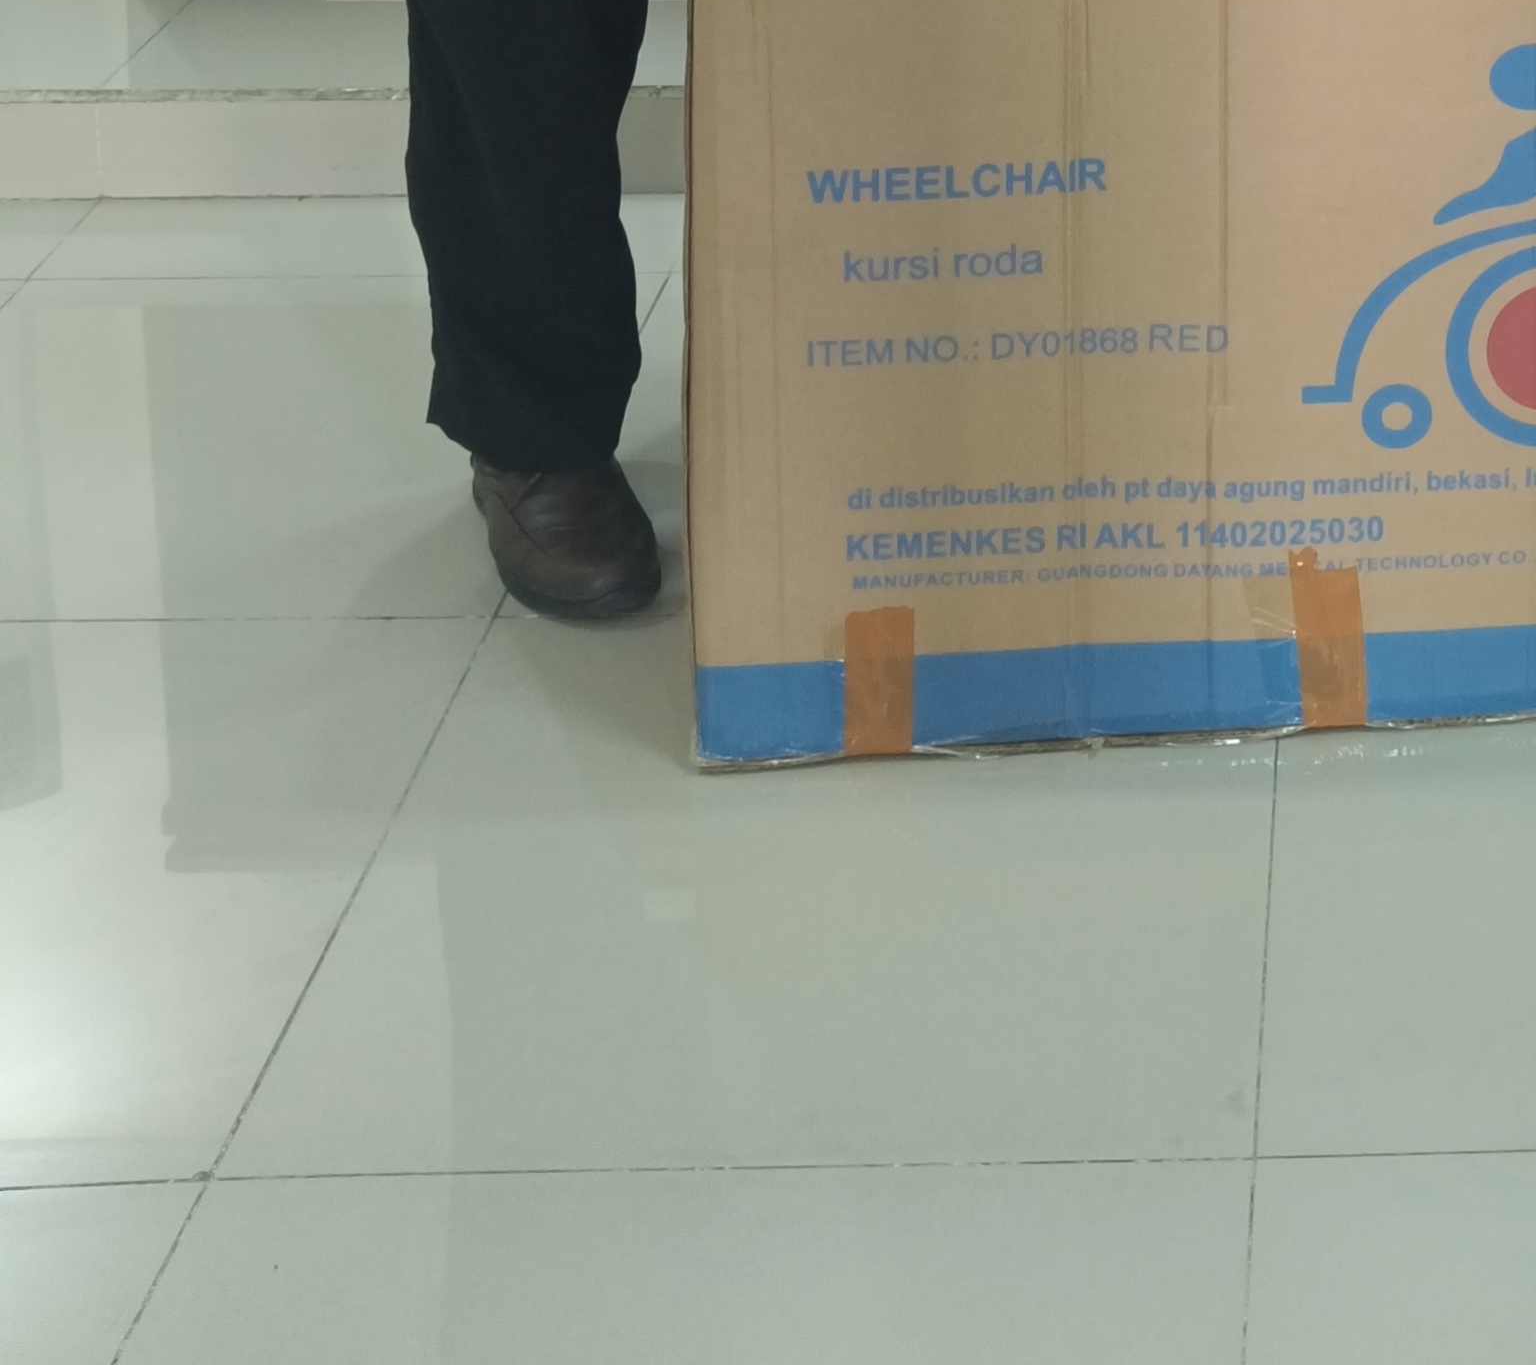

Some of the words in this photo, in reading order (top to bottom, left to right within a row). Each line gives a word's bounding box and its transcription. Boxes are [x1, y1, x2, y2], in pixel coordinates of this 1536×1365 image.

[806, 157, 1108, 205] WHEELCHAIR
[843, 246, 941, 283] kursi
[953, 243, 1043, 278] roda
[806, 338, 894, 367] ITEM
[991, 327, 1138, 361] DY01868
[1149, 323, 1230, 354] RED
[847, 488, 872, 510] di
[878, 481, 1055, 511] distribusikan
[1062, 476, 1117, 502] oleh
[1124, 477, 1150, 503] pt
[1156, 476, 1216, 504] daya
[1223, 477, 1306, 503] agung
[1312, 471, 1419, 495] mandiri,
[1426, 467, 1518, 492] bekasi,
[846, 525, 1046, 562] KEMENKES
[1056, 523, 1086, 550] RI
[1095, 522, 1166, 551] AKL
[1175, 515, 1385, 549] 11402025030
[852, 570, 1031, 590] MANUFACTURER:
[1037, 564, 1168, 582] GUANGDONG
[1173, 562, 1254, 580] DAYANG
[1355, 552, 1493, 572] TECHNOLOGY
